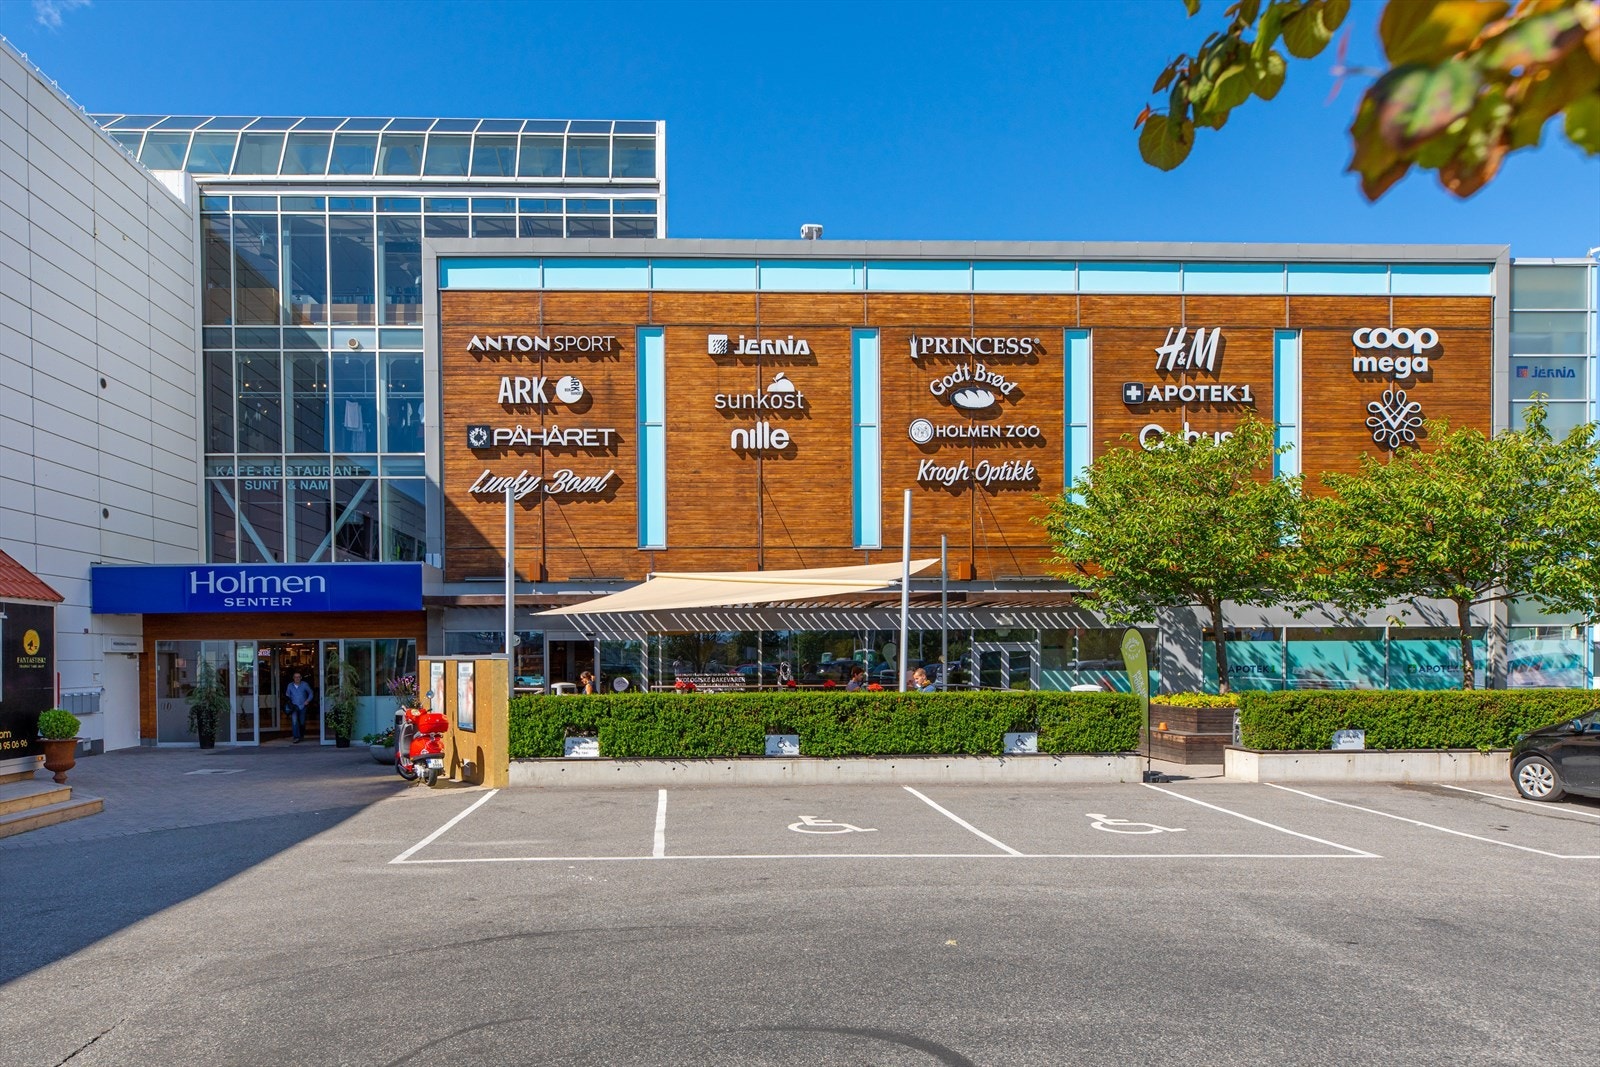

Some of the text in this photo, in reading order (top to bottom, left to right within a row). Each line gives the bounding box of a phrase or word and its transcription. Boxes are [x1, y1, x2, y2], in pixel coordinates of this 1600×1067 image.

[1155, 327, 1220, 372] H&M
[1352, 328, 1439, 354] coop
[1353, 356, 1429, 379] mega
[498, 376, 549, 404] ARK
[929, 363, 1019, 397] Godt Brød
[714, 391, 804, 410] sunkost
[1147, 385, 1253, 402] APOTEK 1
[493, 425, 615, 447] PÅHÅRET
[731, 421, 790, 450] nille
[936, 424, 1040, 438] HOLMEN ZOO
[468, 469, 615, 500] Lucky Bowl
[917, 459, 1035, 486] Krogh Optikk
[190, 570, 326, 594] Holmen
[224, 597, 293, 607] SENTER
[1228, 665, 1269, 673] APOTEK
